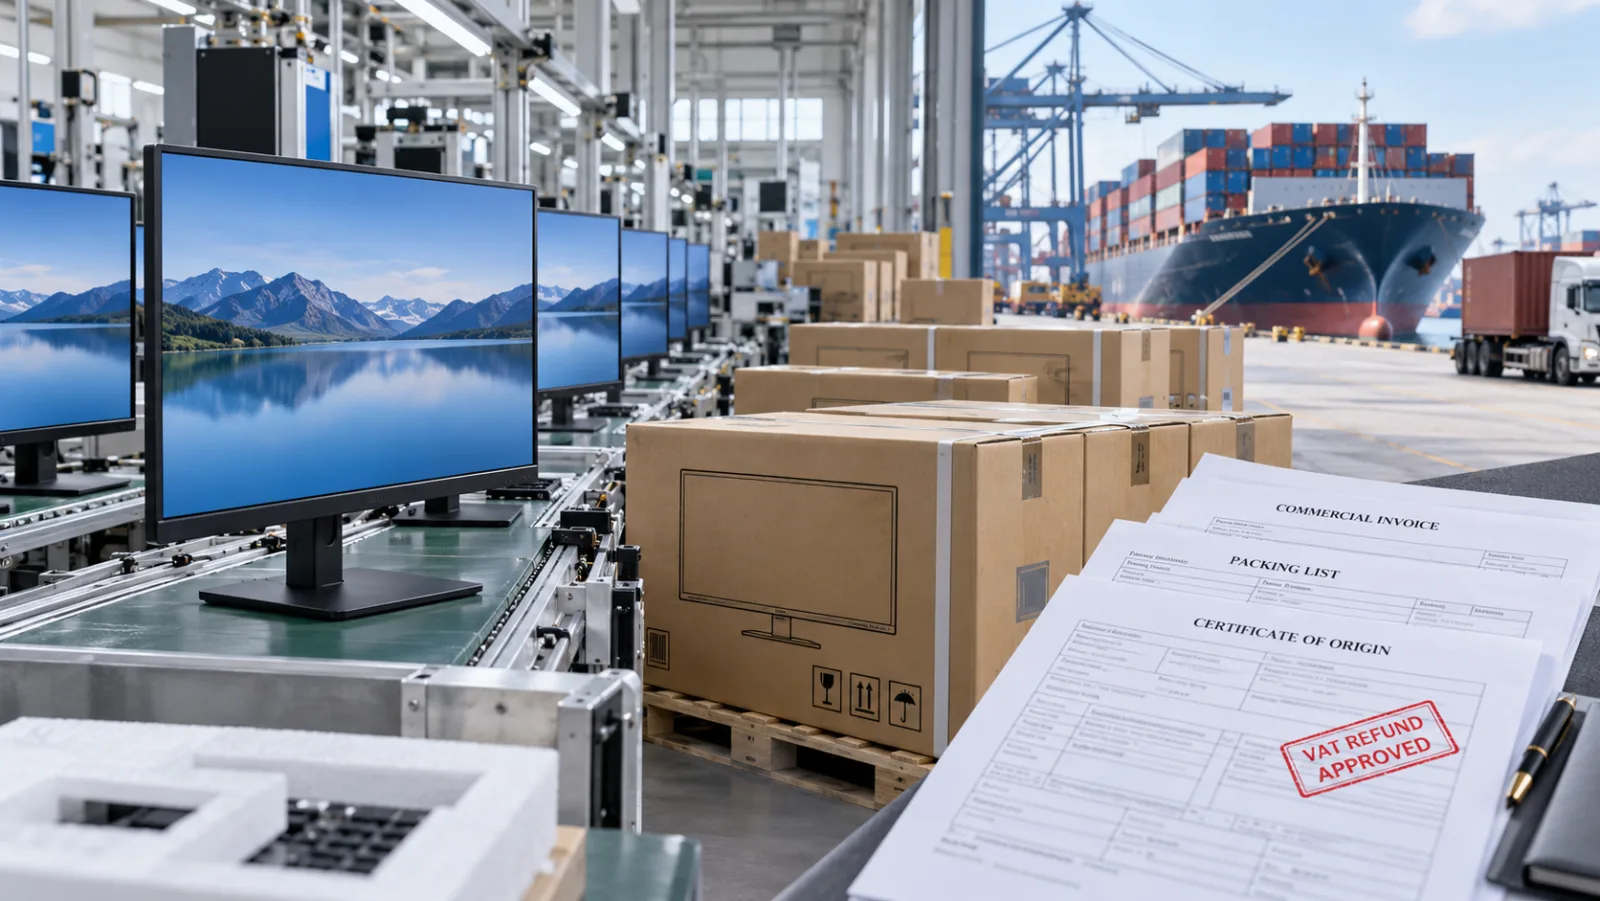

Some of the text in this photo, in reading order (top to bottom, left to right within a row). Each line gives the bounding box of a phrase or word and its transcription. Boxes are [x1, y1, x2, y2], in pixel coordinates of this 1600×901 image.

[1276, 503, 1440, 531] COMMERCIAL INVOICE
[1229, 556, 1341, 579] PACKING LIST
[1193, 617, 1392, 656] CERTIFICATE OF ORIGIN
[1302, 739, 1340, 762] VAT
[1344, 716, 1423, 750] REFUND
[1319, 737, 1431, 783] APPROVED
